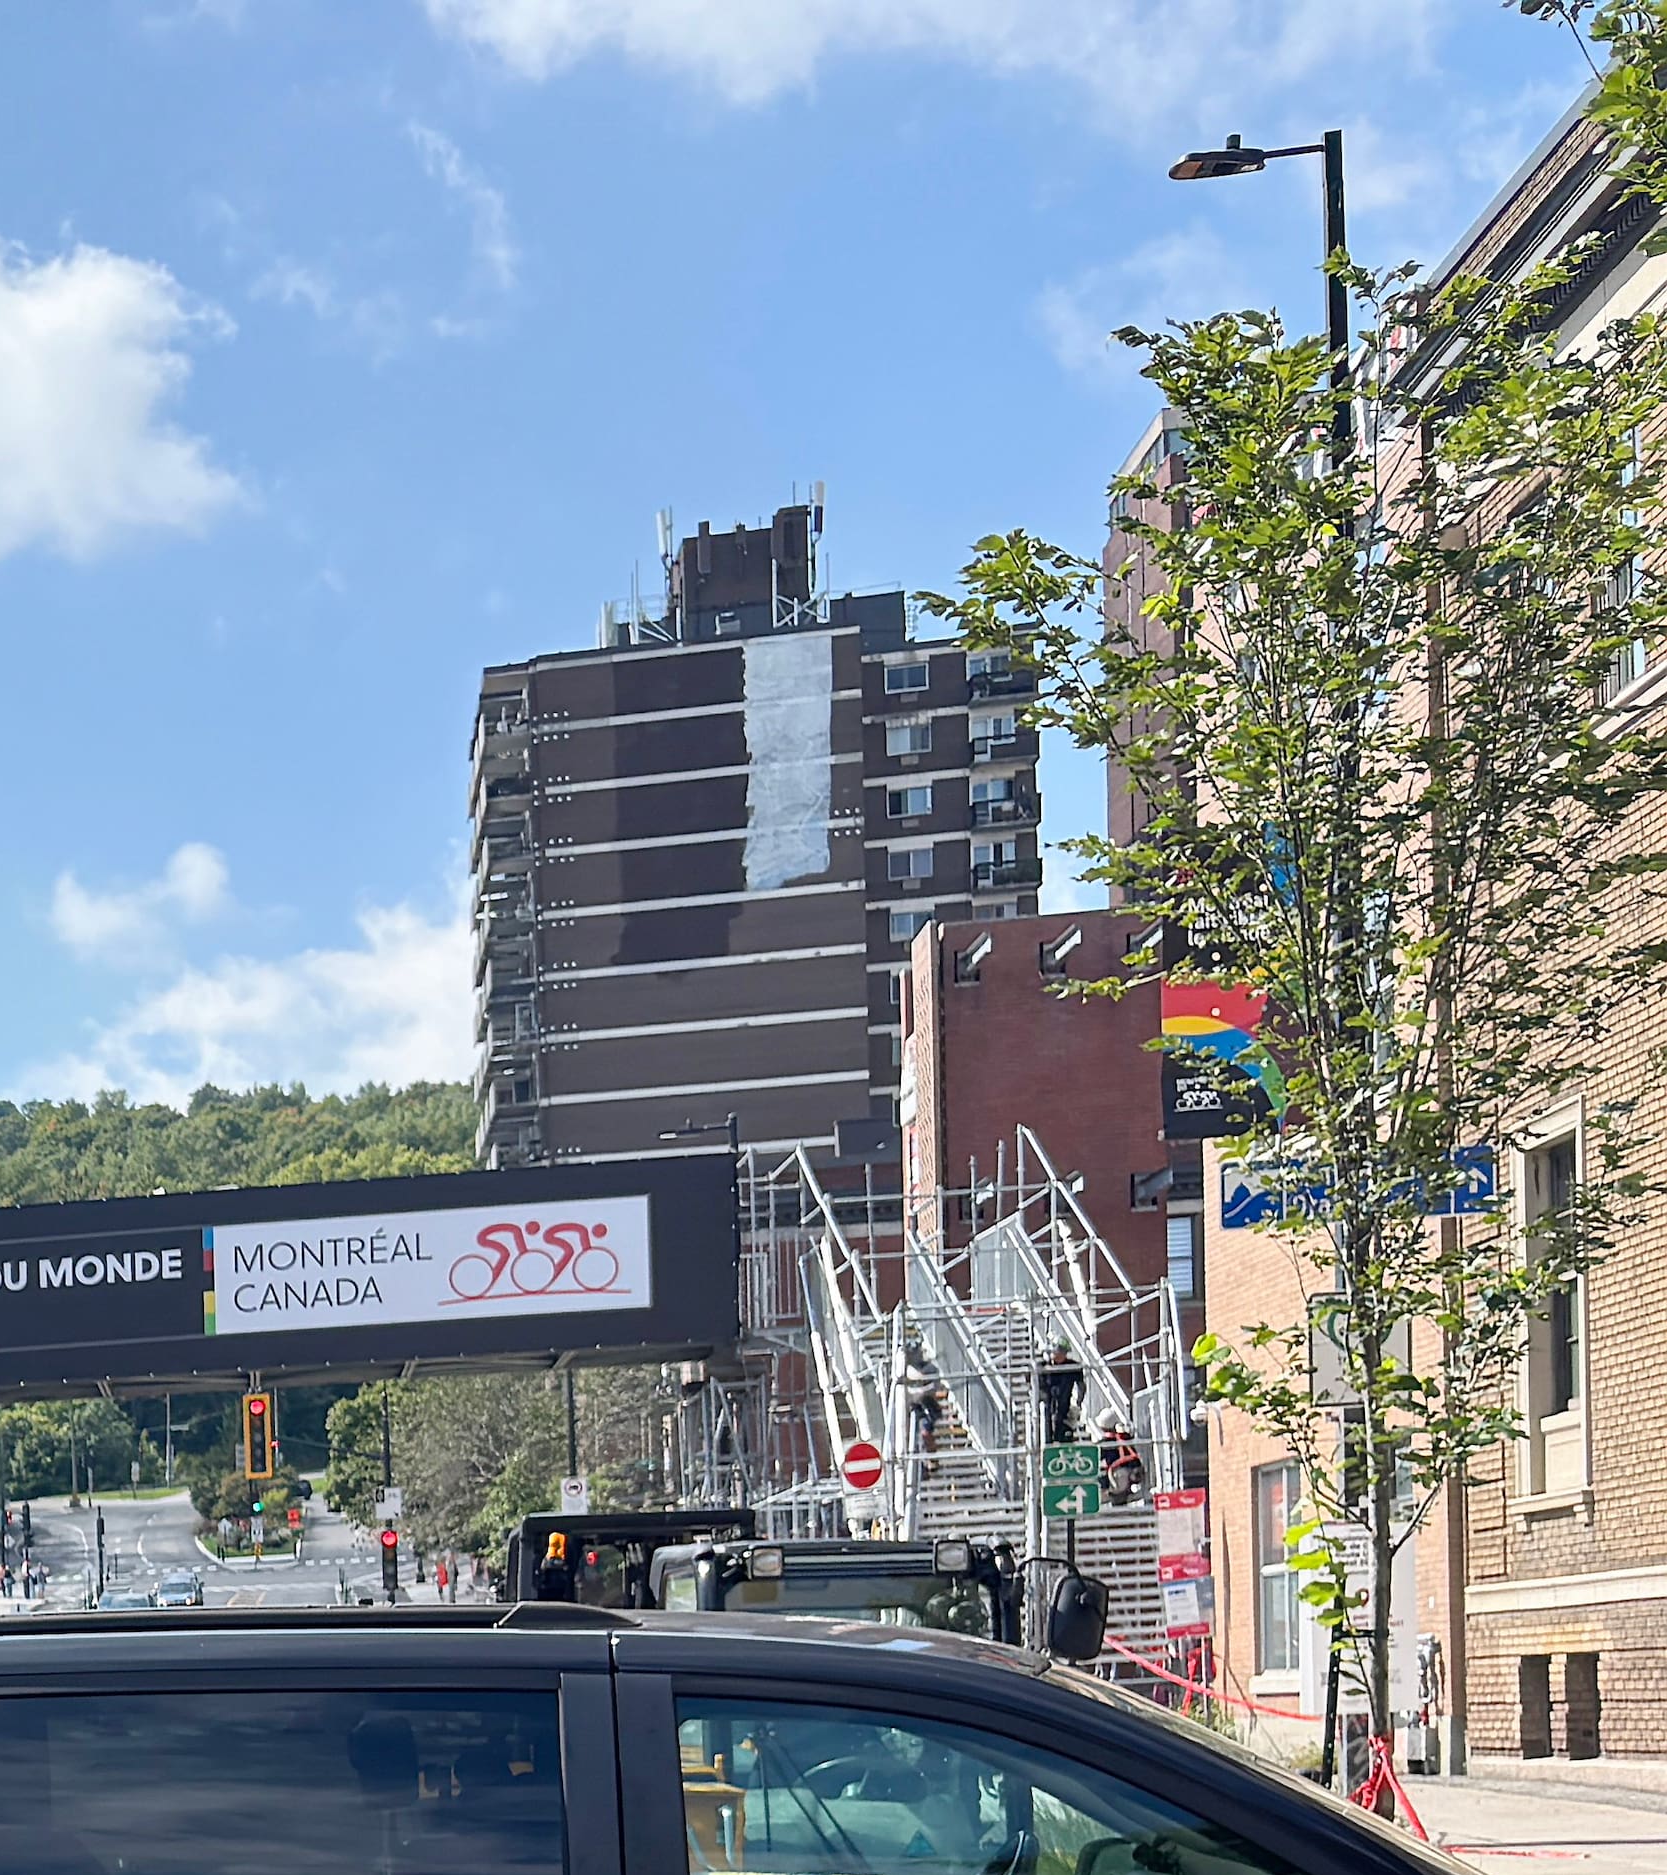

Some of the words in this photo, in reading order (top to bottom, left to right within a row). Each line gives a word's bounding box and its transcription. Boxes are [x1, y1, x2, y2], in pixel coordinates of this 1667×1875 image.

[39, 1248, 183, 1289] MONDE
[234, 1227, 433, 1274] MONTRÉAL
[234, 1275, 383, 1313] CANADA
